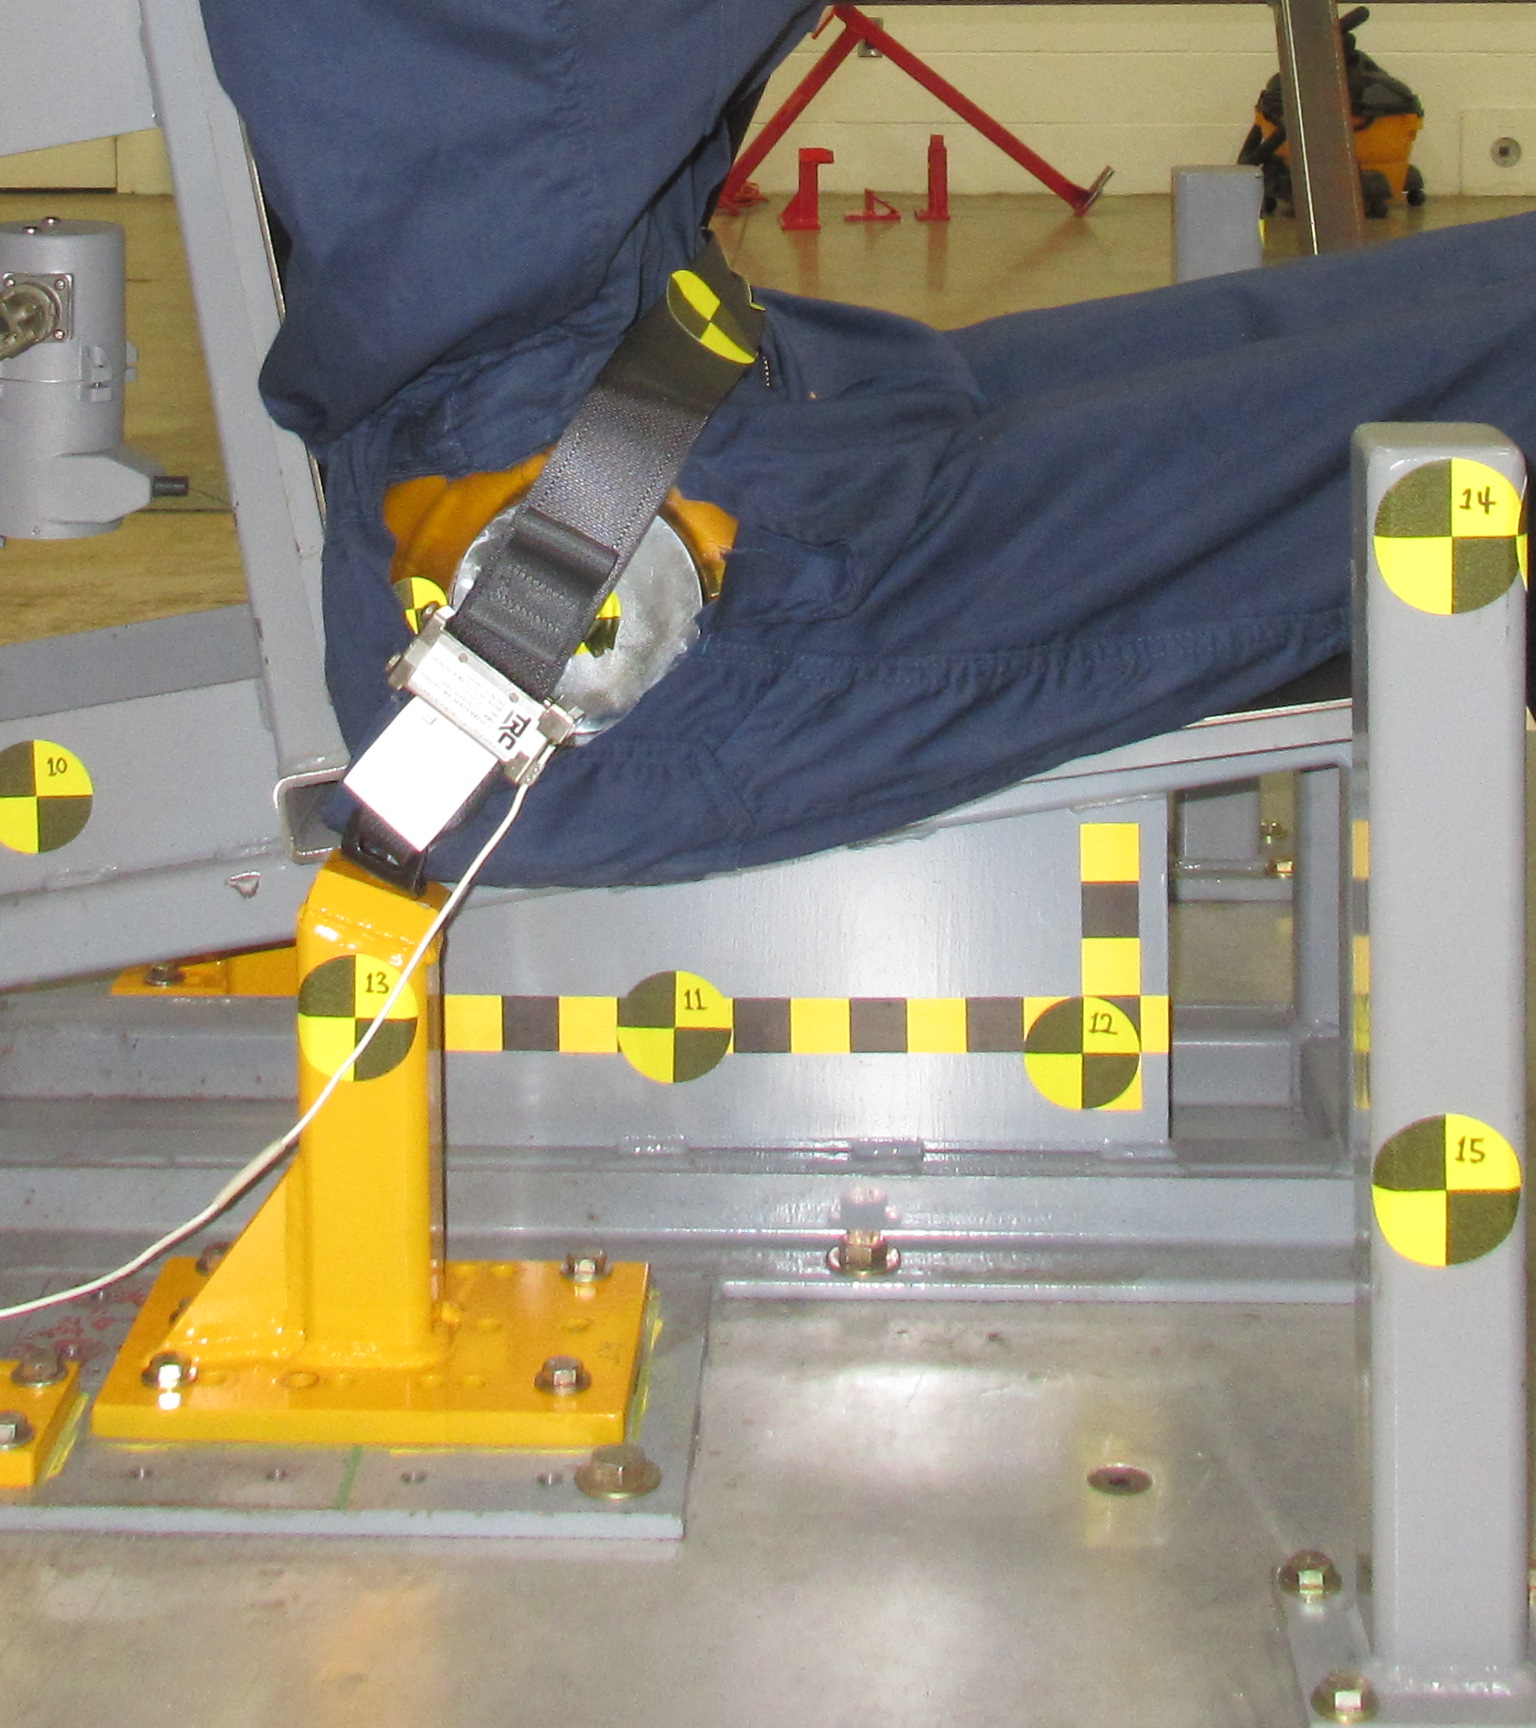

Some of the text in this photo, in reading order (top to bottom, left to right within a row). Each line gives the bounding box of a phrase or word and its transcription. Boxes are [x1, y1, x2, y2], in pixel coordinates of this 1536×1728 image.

[1459, 486, 1497, 515] 14
[498, 713, 532, 751] TRC
[47, 756, 69, 777] 10
[365, 971, 390, 995] 13
[683, 987, 708, 1011] 11
[1088, 1010, 1119, 1035] 12
[1455, 1135, 1486, 1165] 15
